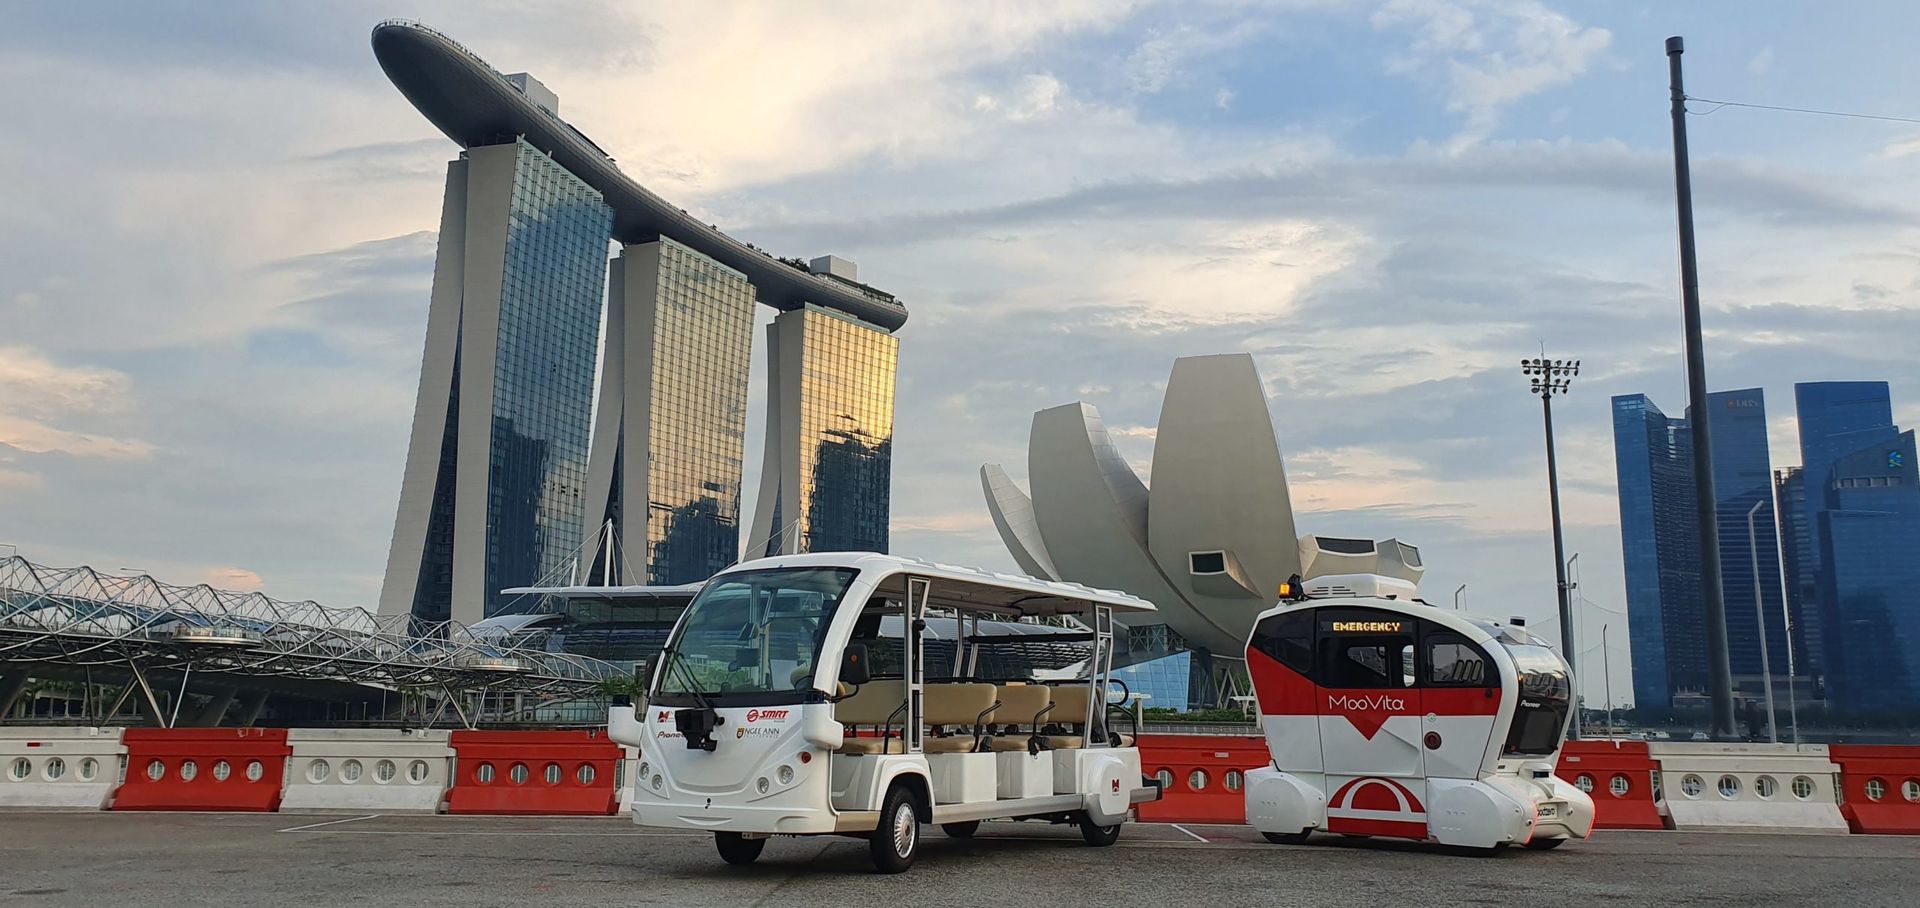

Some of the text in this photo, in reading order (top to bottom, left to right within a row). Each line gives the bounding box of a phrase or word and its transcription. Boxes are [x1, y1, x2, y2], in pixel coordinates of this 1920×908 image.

[1333, 622, 1400, 632] EMERGENCY
[1328, 694, 1405, 710] MooVita
[759, 710, 789, 719] SMRT
[745, 727, 780, 735] NGEE ANN
